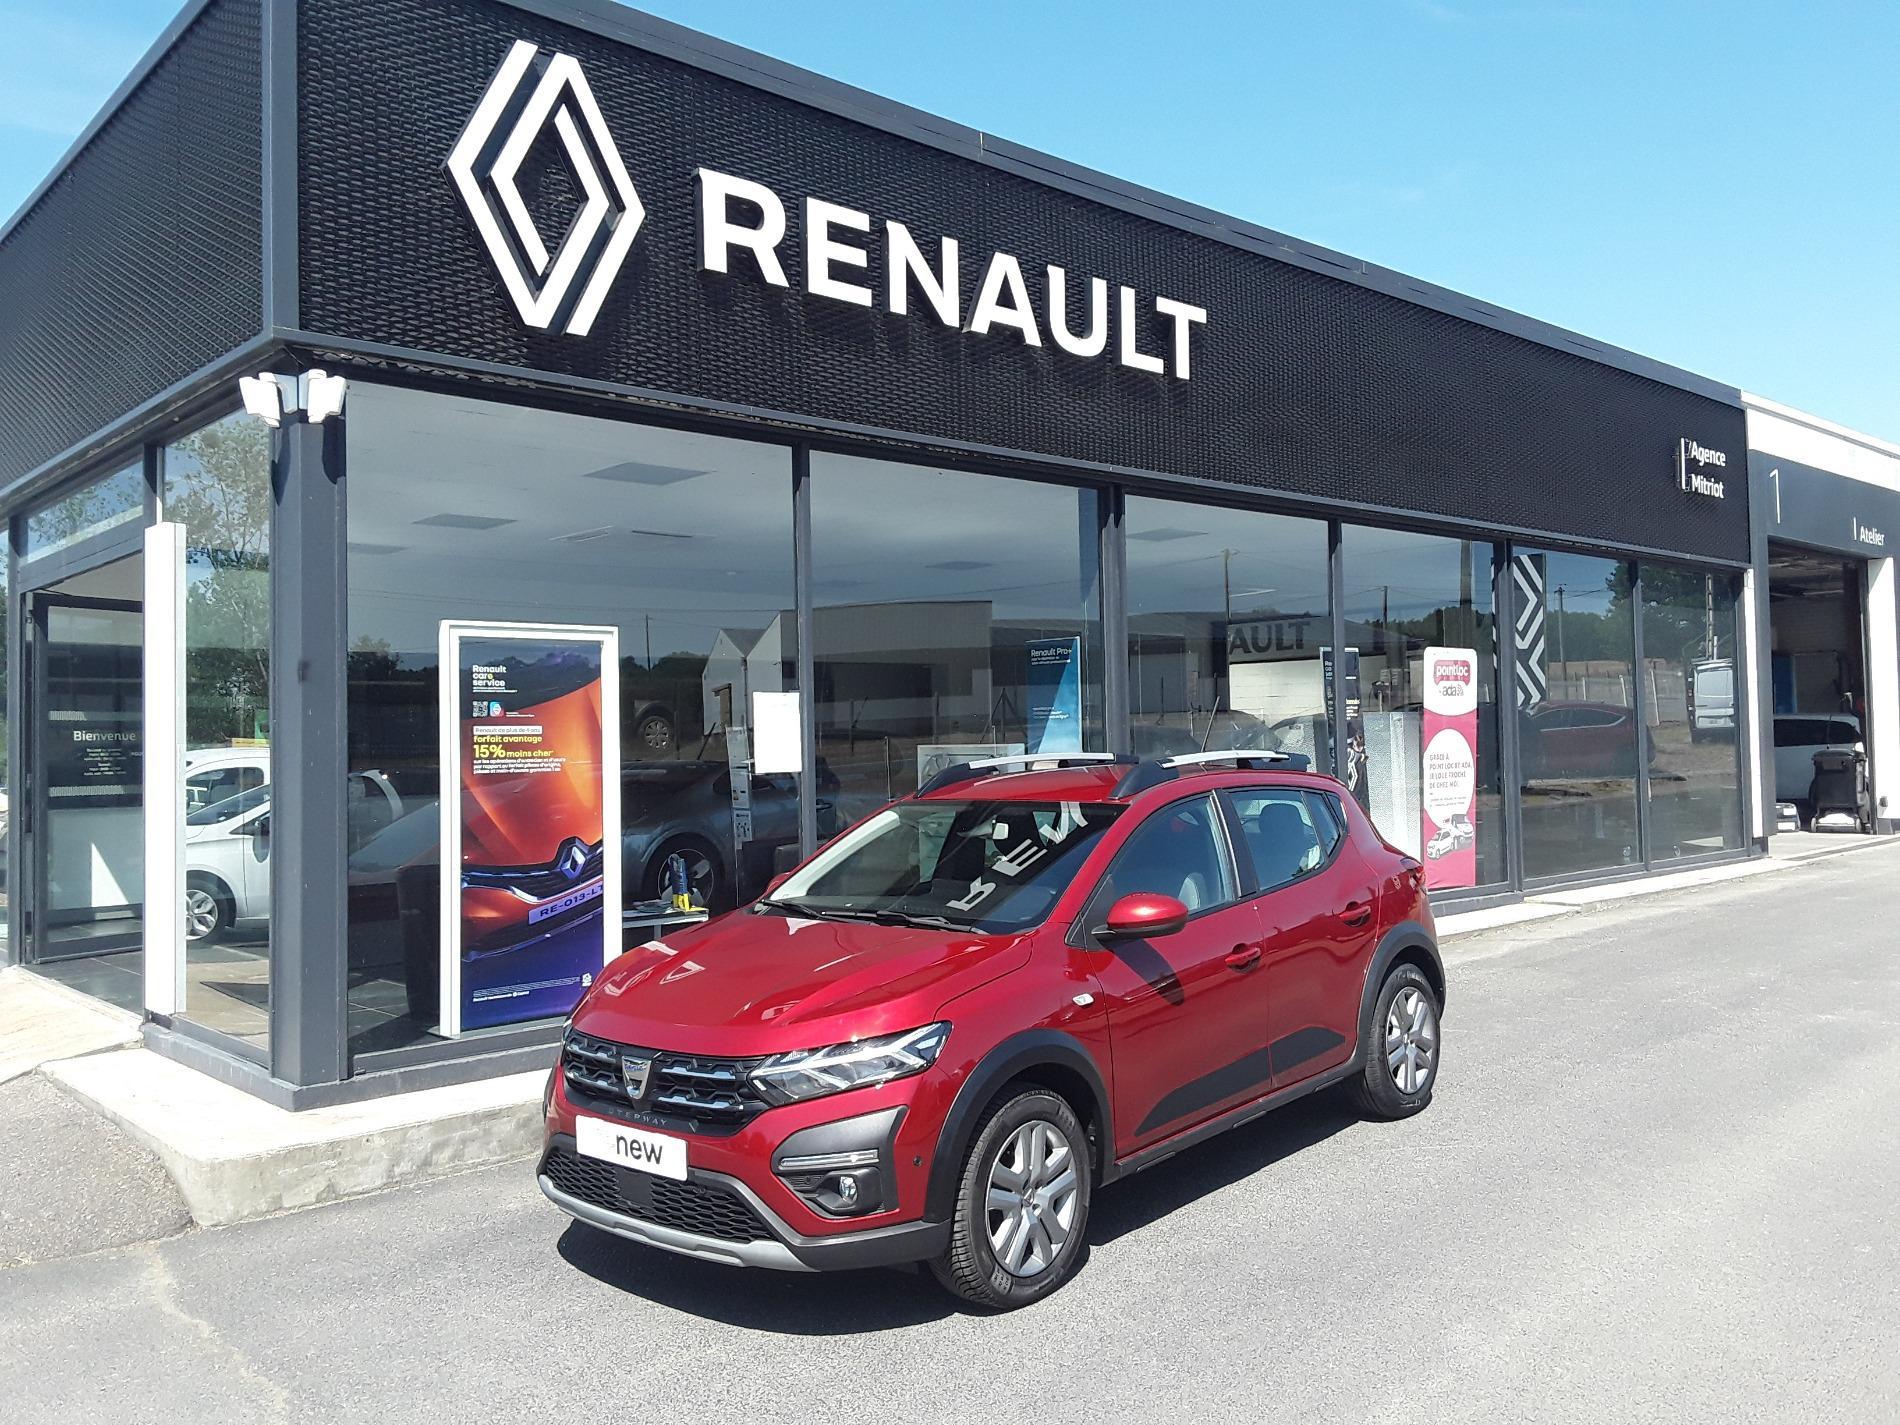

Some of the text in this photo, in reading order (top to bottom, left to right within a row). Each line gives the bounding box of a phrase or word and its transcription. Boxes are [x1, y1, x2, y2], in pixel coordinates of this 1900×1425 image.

[696, 167, 1208, 381] RENAULT
[1691, 441, 1726, 467] Agence
[1691, 473, 1724, 499] Mitriot
[1860, 525, 1886, 547] Atelier
[1031, 648, 1056, 657] Renault
[472, 664, 507, 673] Renault
[472, 672, 494, 680] care
[472, 679, 506, 687] service
[73, 730, 136, 742] Bienvenue
[473, 735, 543, 744] forfait avantage
[473, 744, 507, 758] 15%
[506, 750, 532, 758] moins
[616, 1134, 663, 1166] new
